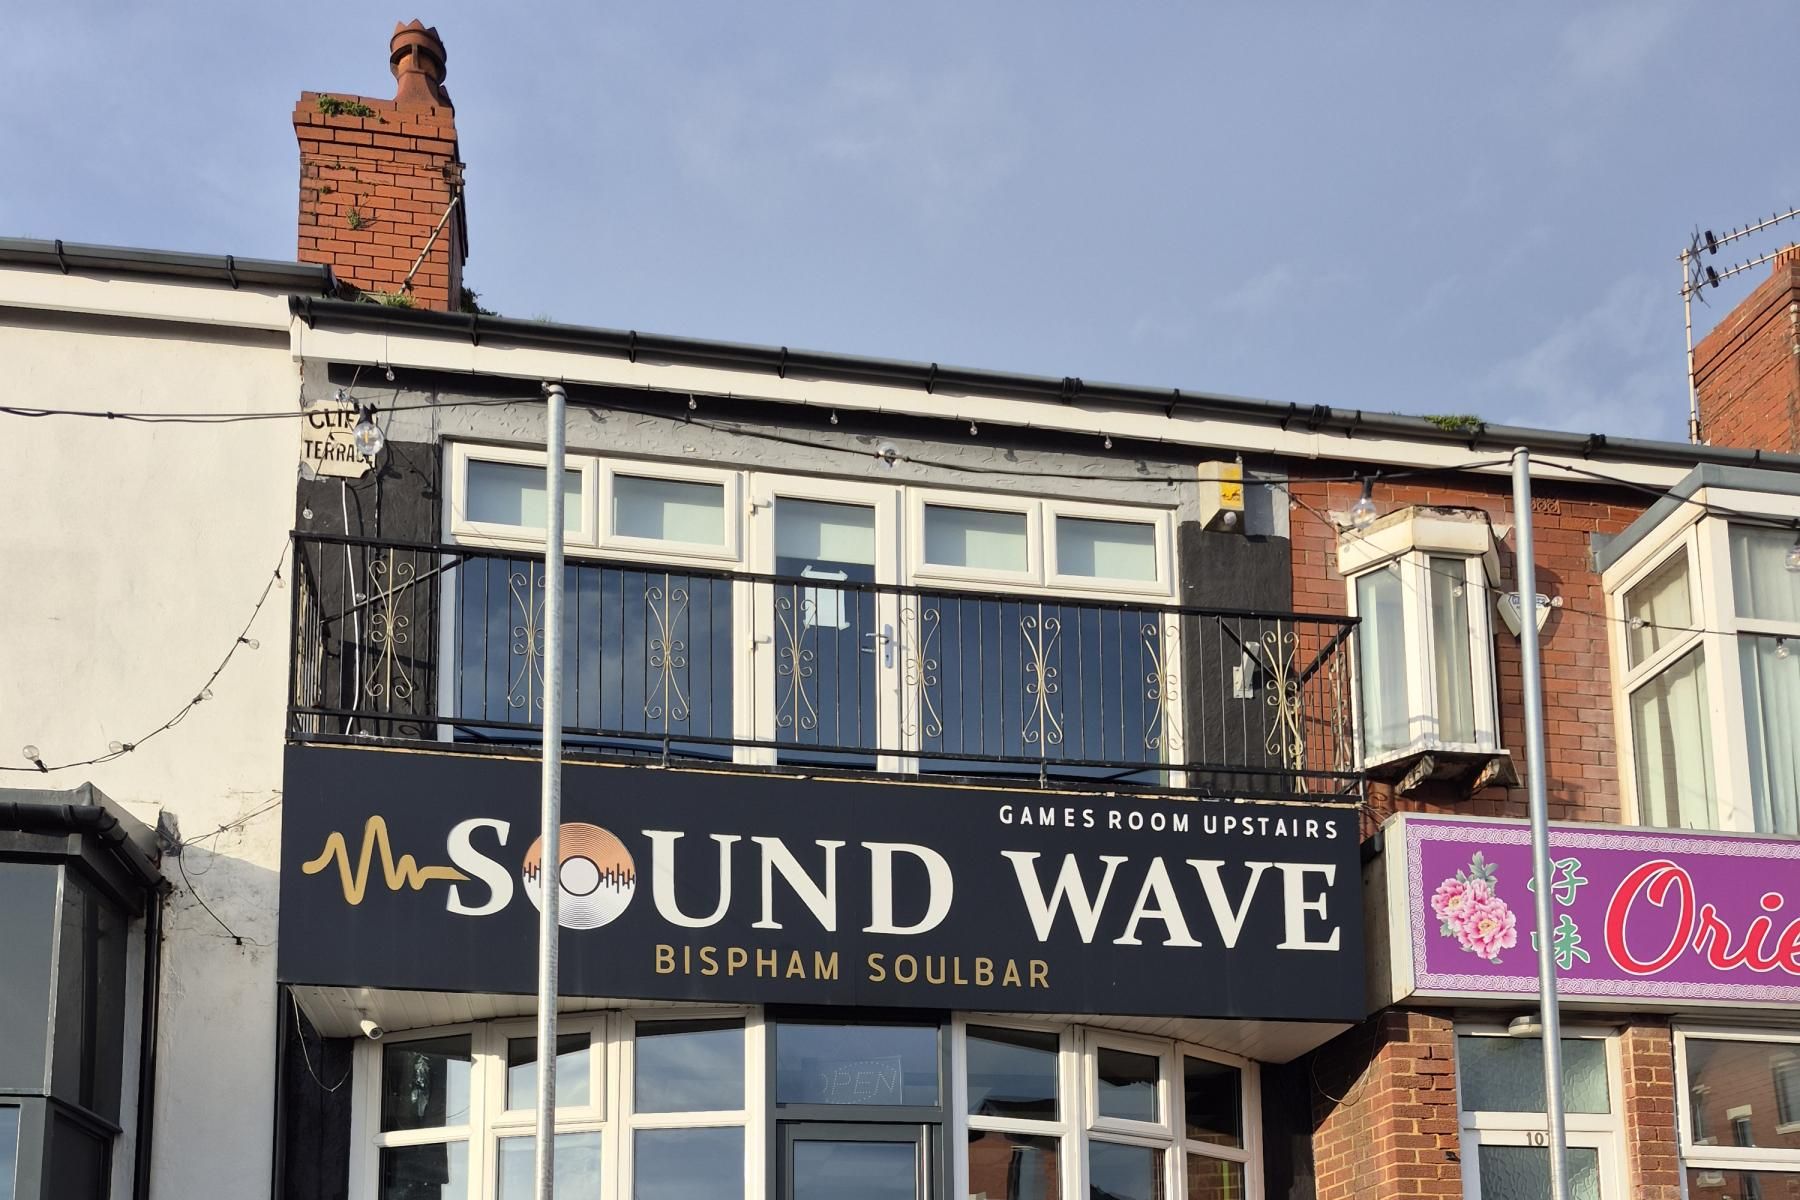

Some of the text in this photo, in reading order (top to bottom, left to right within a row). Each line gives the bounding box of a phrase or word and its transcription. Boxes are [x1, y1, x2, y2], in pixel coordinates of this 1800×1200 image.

[309, 408, 362, 429] CLIF
[1000, 804, 1338, 840] GAMES ROOM UPSTAIRS
[446, 817, 1341, 951] SOUND WAVE
[655, 943, 1050, 989] BISPHAM SOULBAR
[1526, 1131, 1550, 1147] 10
